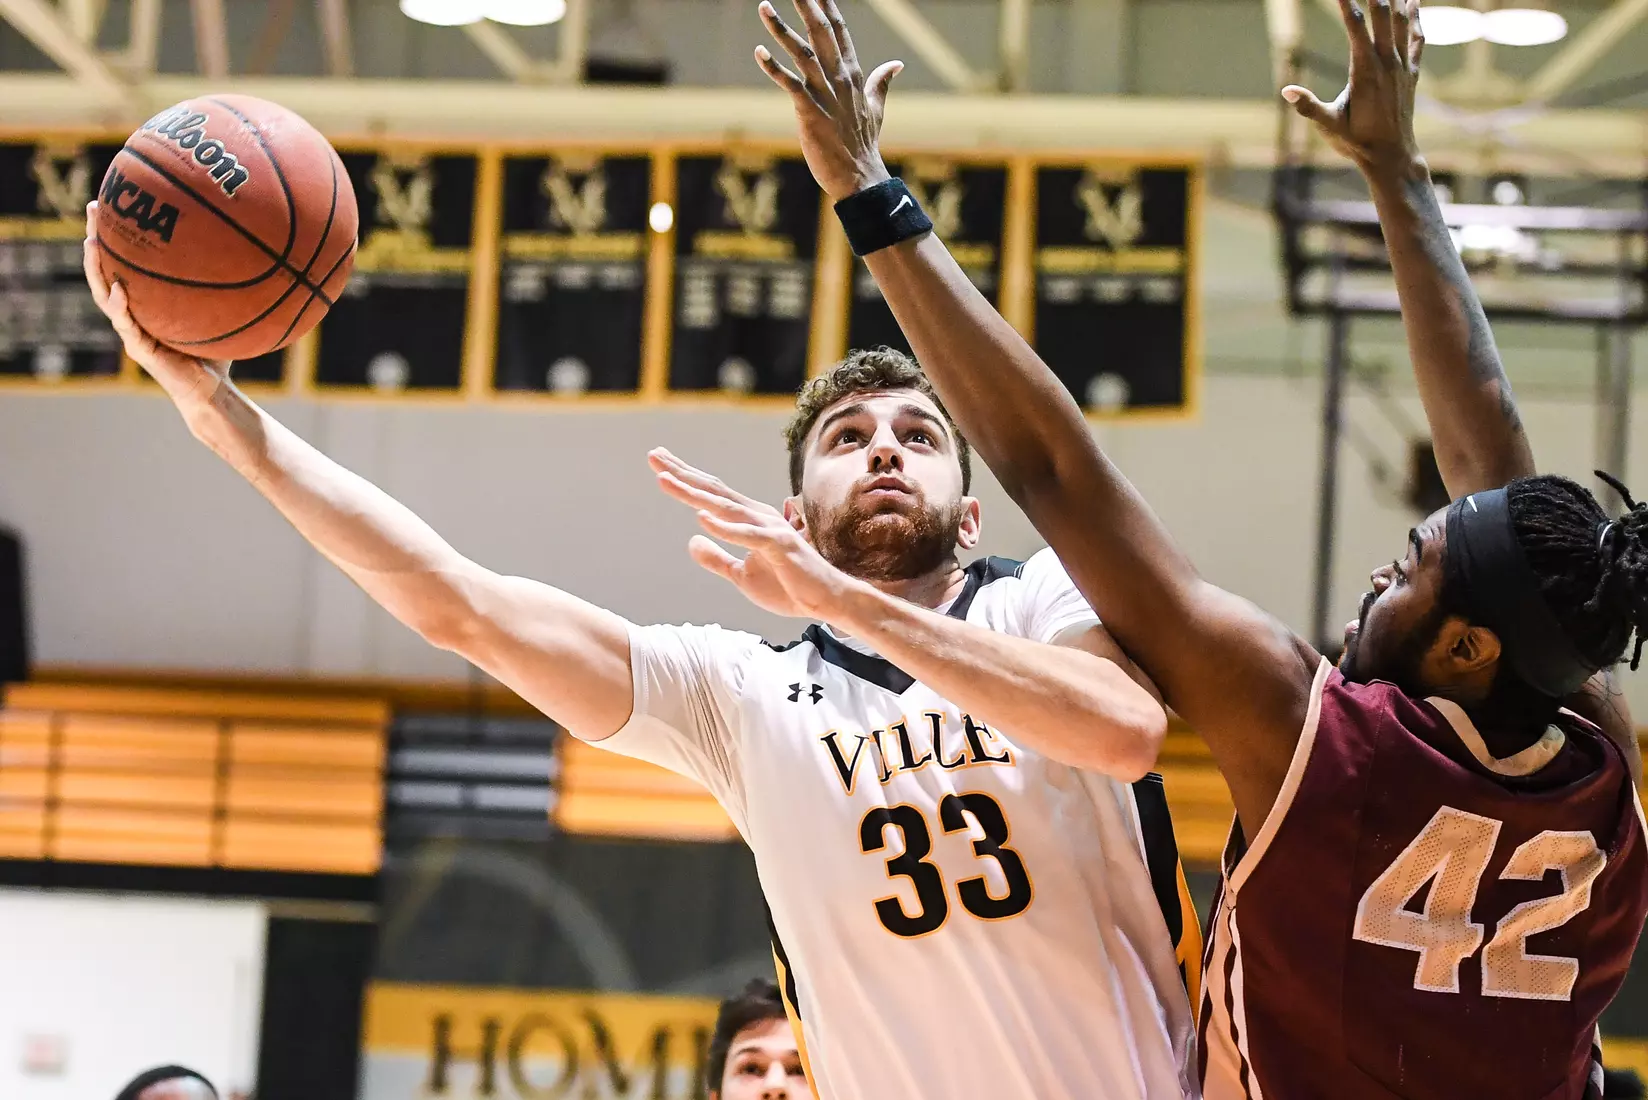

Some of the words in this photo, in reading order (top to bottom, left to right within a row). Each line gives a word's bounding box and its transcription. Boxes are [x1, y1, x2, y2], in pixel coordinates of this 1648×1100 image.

[99, 167, 181, 243] NCAA
[819, 711, 1016, 795] VILLE
[857, 789, 1035, 940] 33
[1352, 805, 1608, 1001] 42
